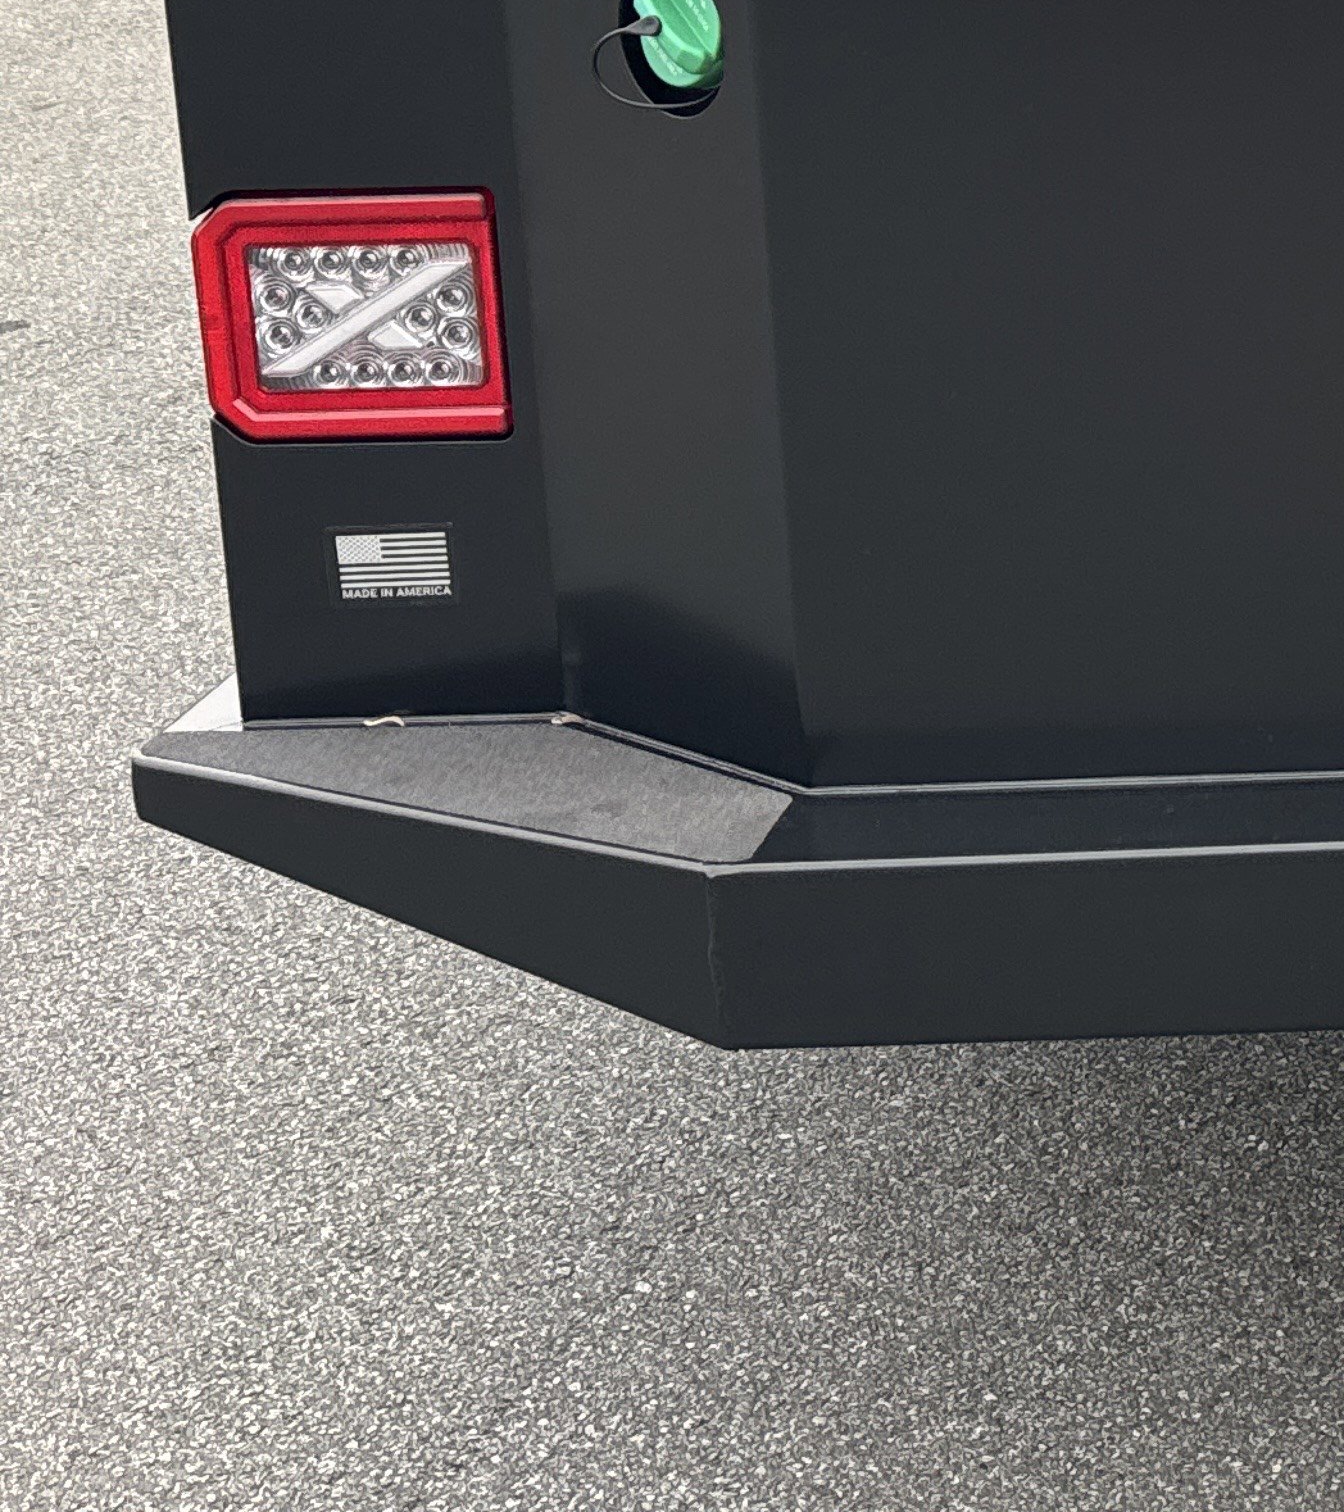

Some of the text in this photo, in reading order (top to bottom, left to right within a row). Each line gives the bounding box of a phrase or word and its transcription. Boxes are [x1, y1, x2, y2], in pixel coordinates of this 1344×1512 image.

[342, 586, 452, 599] MADE IN AMERICA
